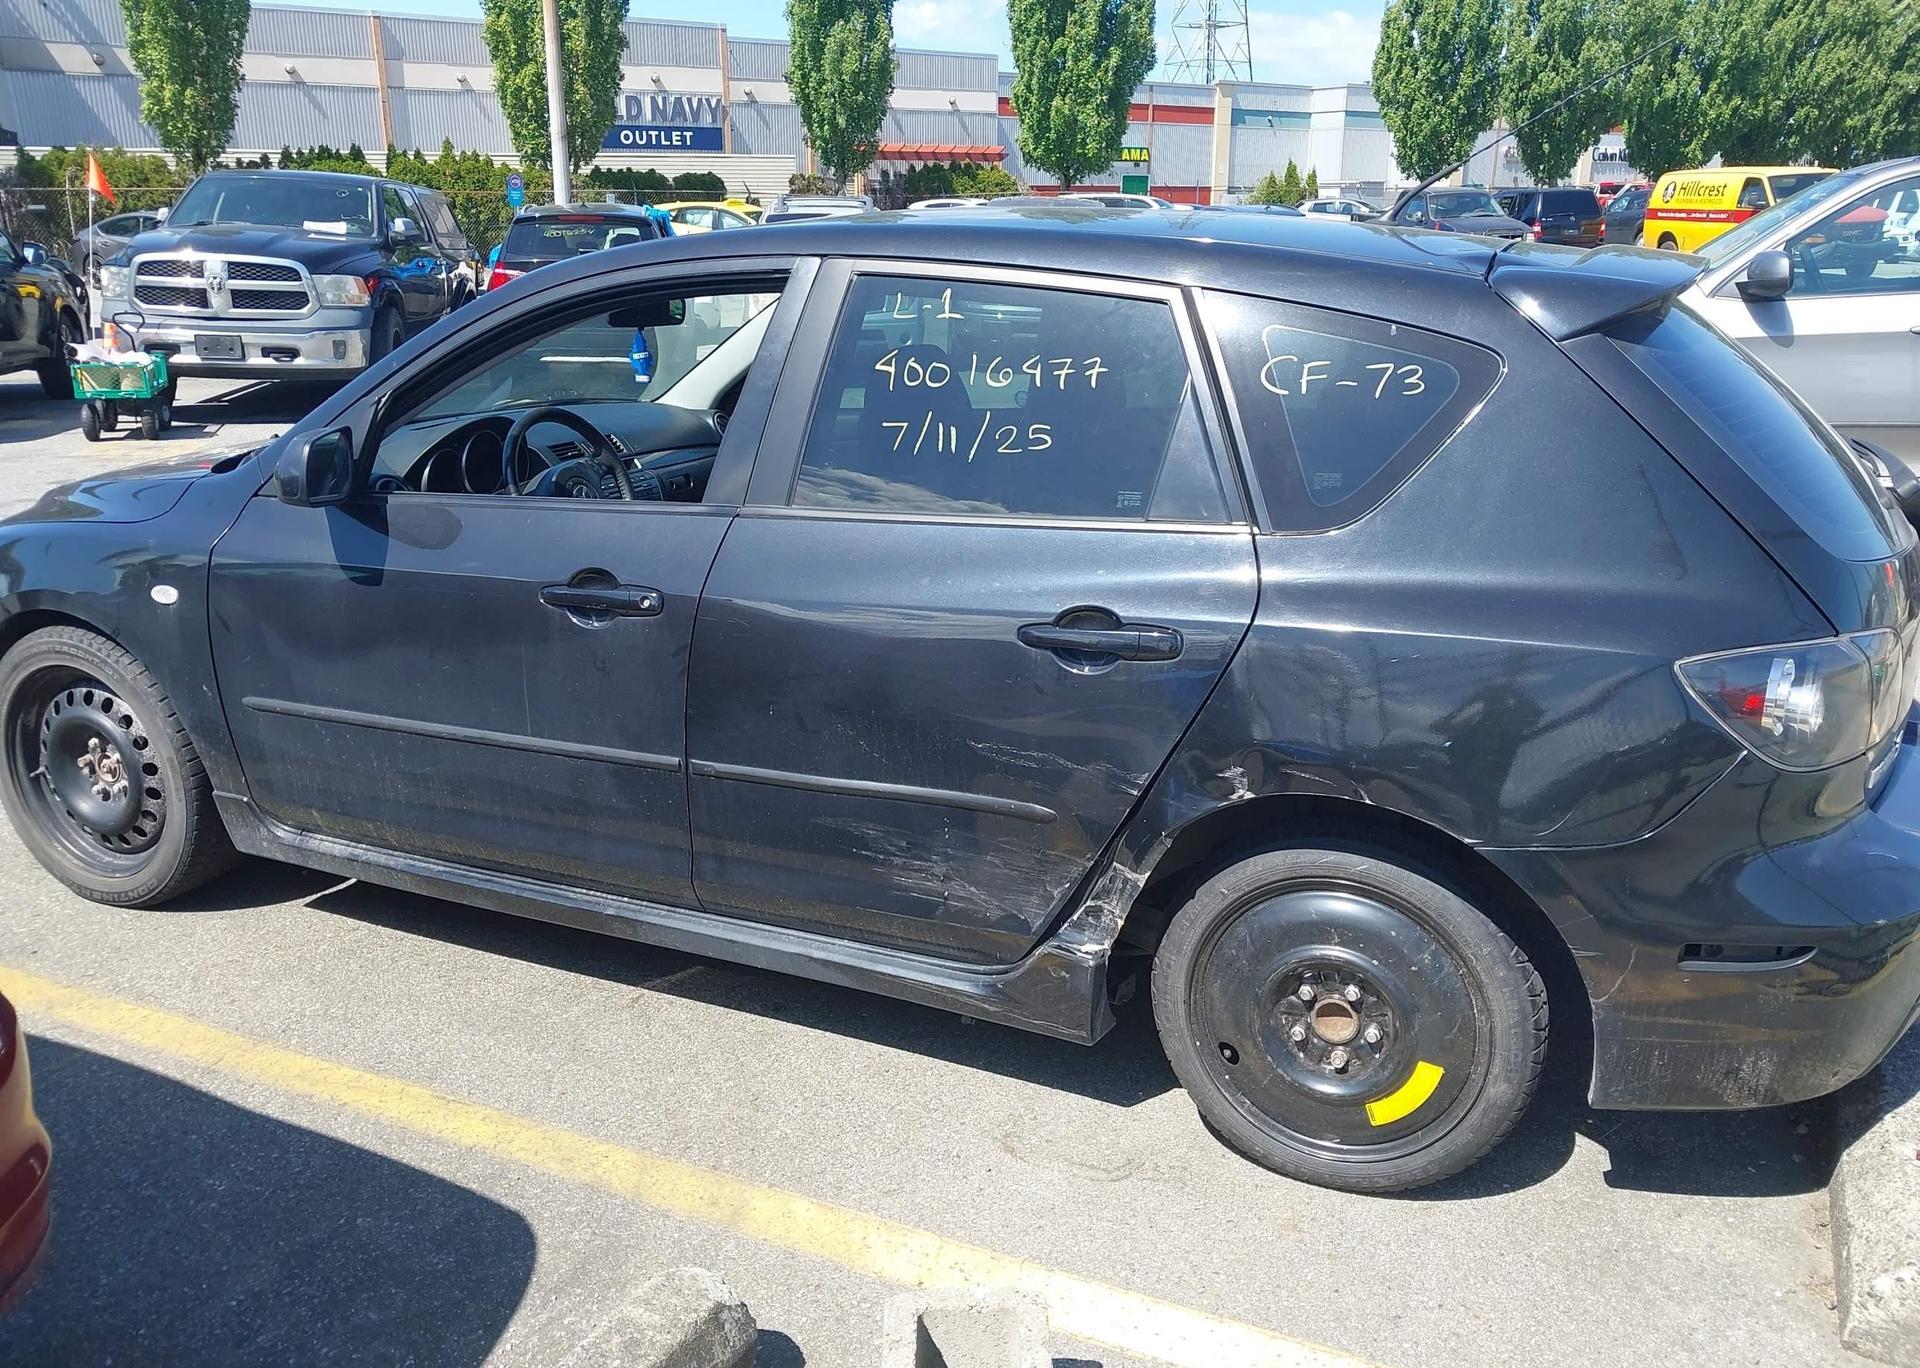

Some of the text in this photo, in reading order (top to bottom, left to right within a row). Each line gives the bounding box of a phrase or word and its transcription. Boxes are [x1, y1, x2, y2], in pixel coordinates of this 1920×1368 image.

[650, 96, 722, 123] NAVY
[620, 130, 693, 146] OUTLET
[1121, 148, 1149, 161] AMA
[1677, 181, 1728, 197] Hillcrest
[893, 287, 965, 319] L-1
[1260, 355, 1426, 399] CF-73
[881, 410, 1053, 464] 7/11/25
